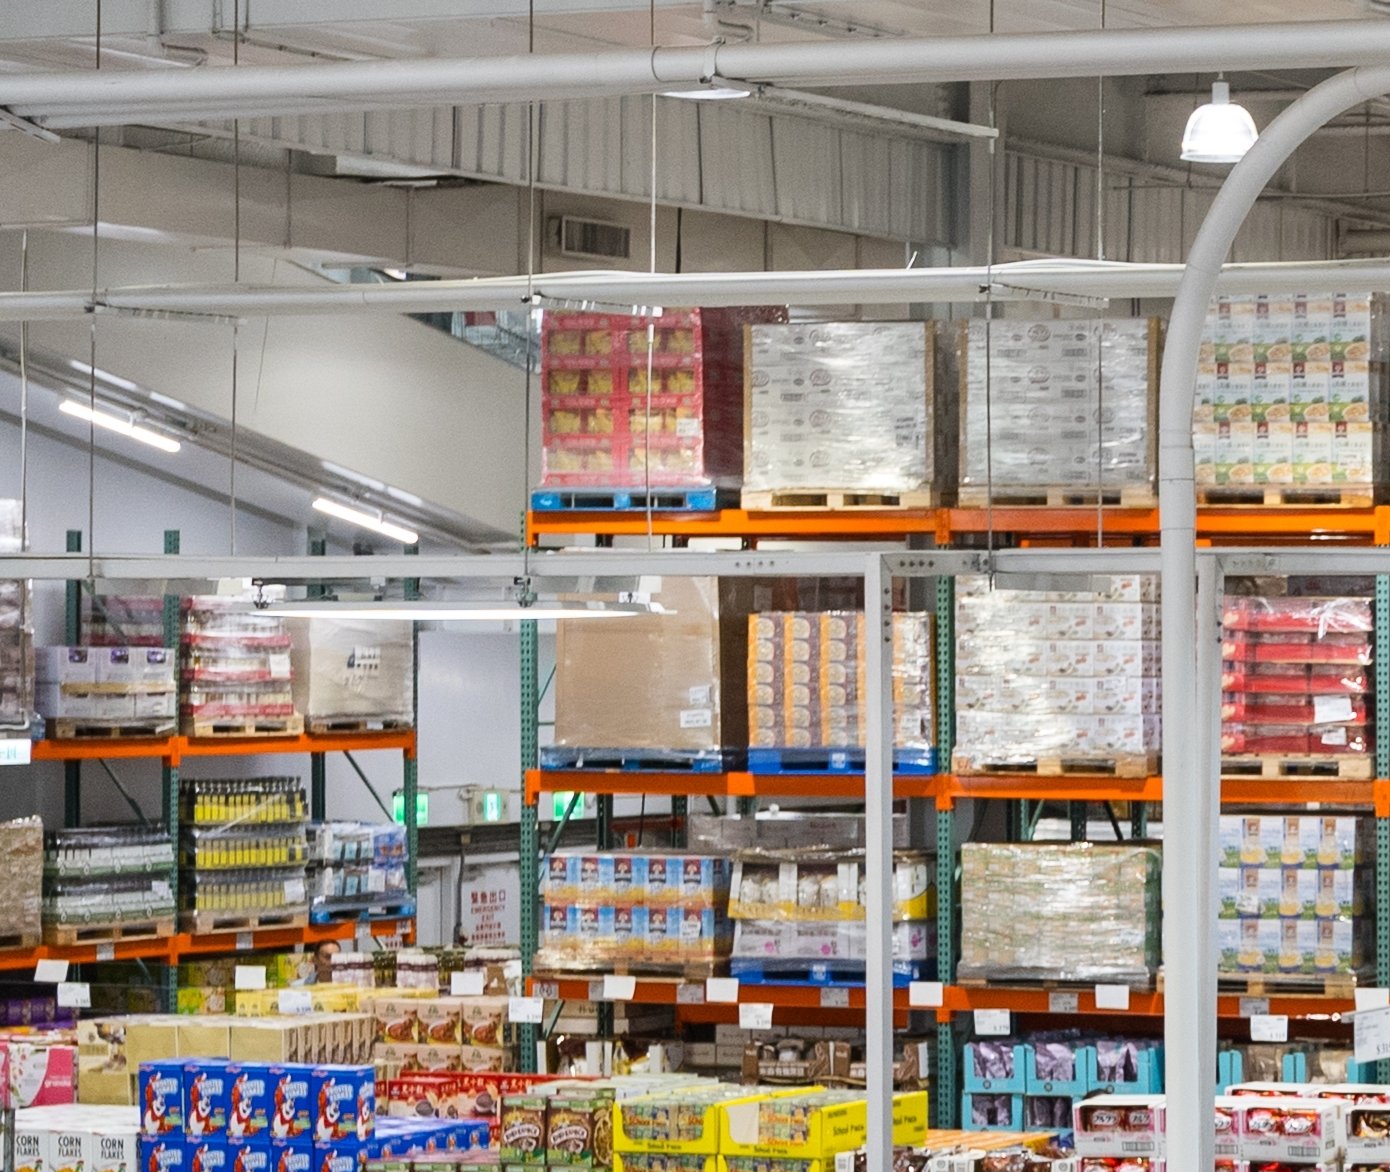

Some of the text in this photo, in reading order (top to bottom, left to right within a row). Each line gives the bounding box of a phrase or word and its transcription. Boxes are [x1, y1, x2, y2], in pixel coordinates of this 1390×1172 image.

[16, 1135, 39, 1147] CORN
[58, 1136, 81, 1148] CORN
[100, 1138, 124, 1150] CORN
[16, 1148, 40, 1157] FLAKES
[58, 1149, 82, 1158] FLAKES
[101, 1151, 124, 1160] FLAKES
